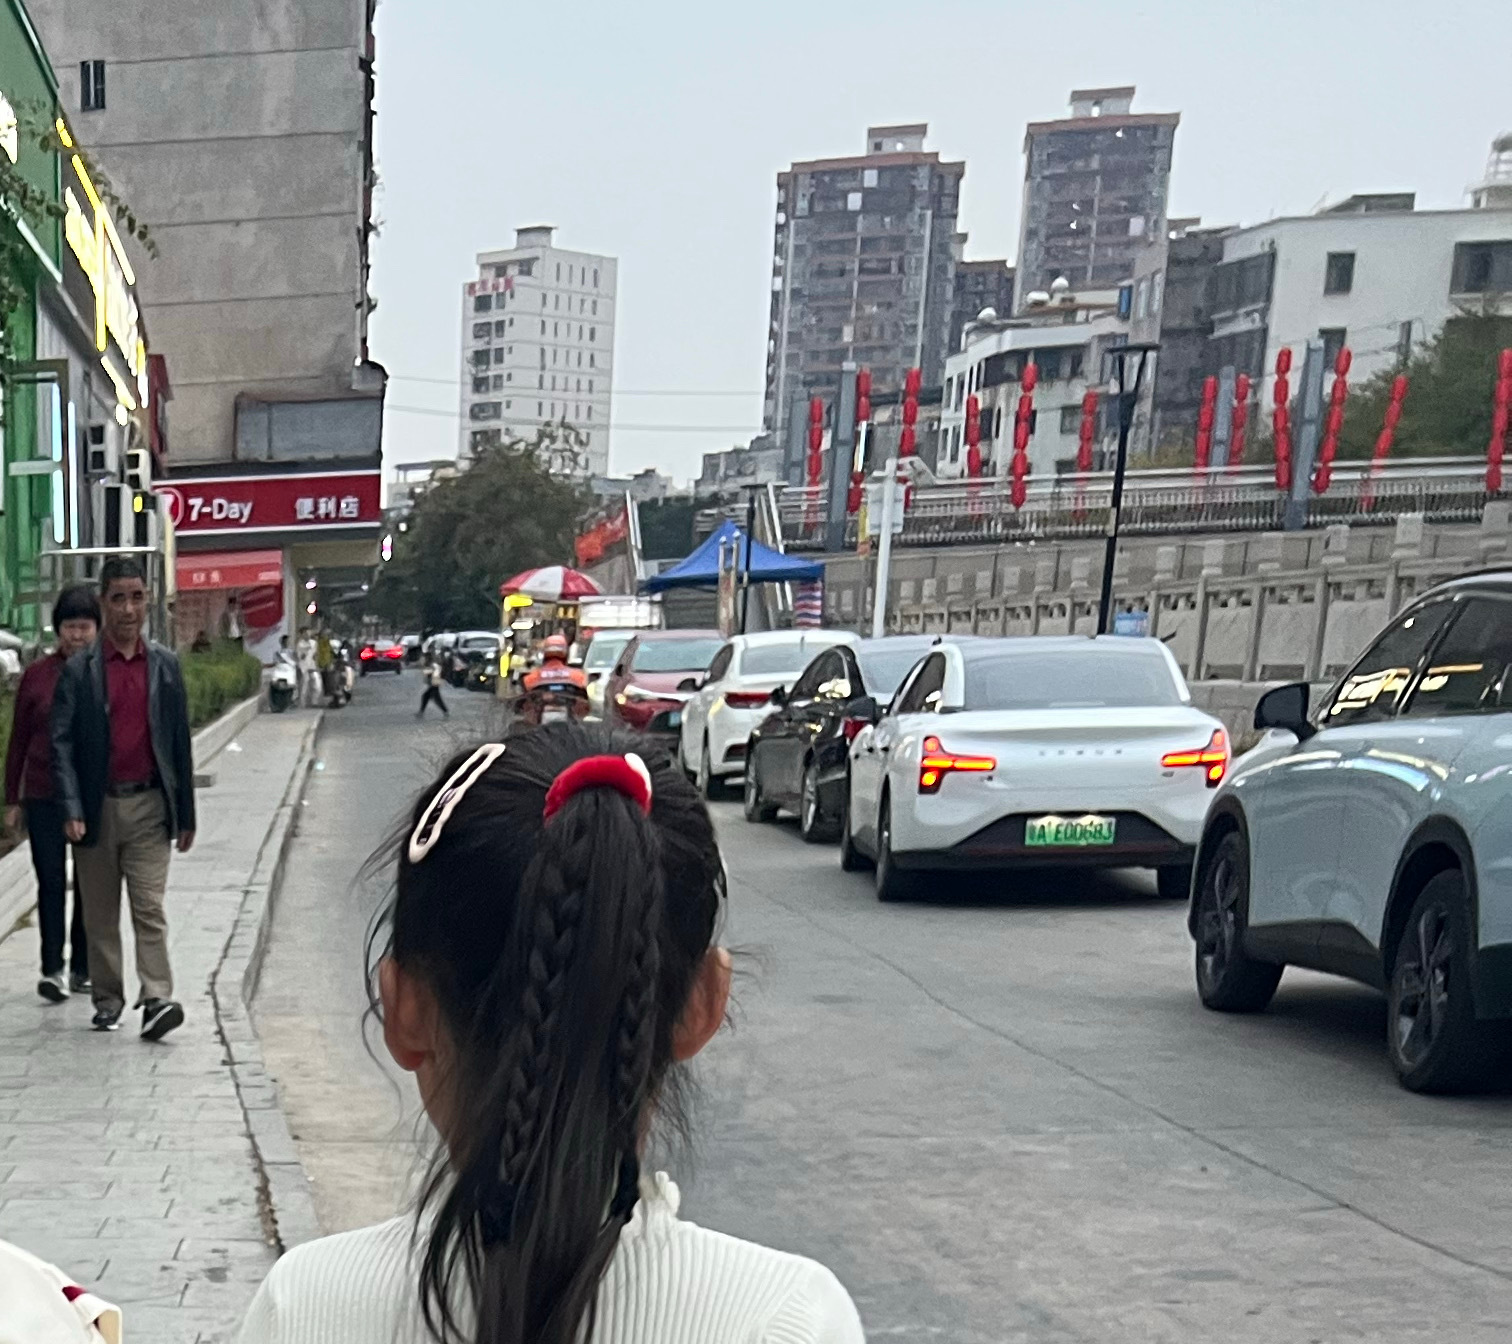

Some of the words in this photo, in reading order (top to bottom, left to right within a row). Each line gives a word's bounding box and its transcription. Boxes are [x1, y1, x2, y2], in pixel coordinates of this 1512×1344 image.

[188, 498, 252, 523] 7-Day
[294, 496, 359, 519] 便利店
